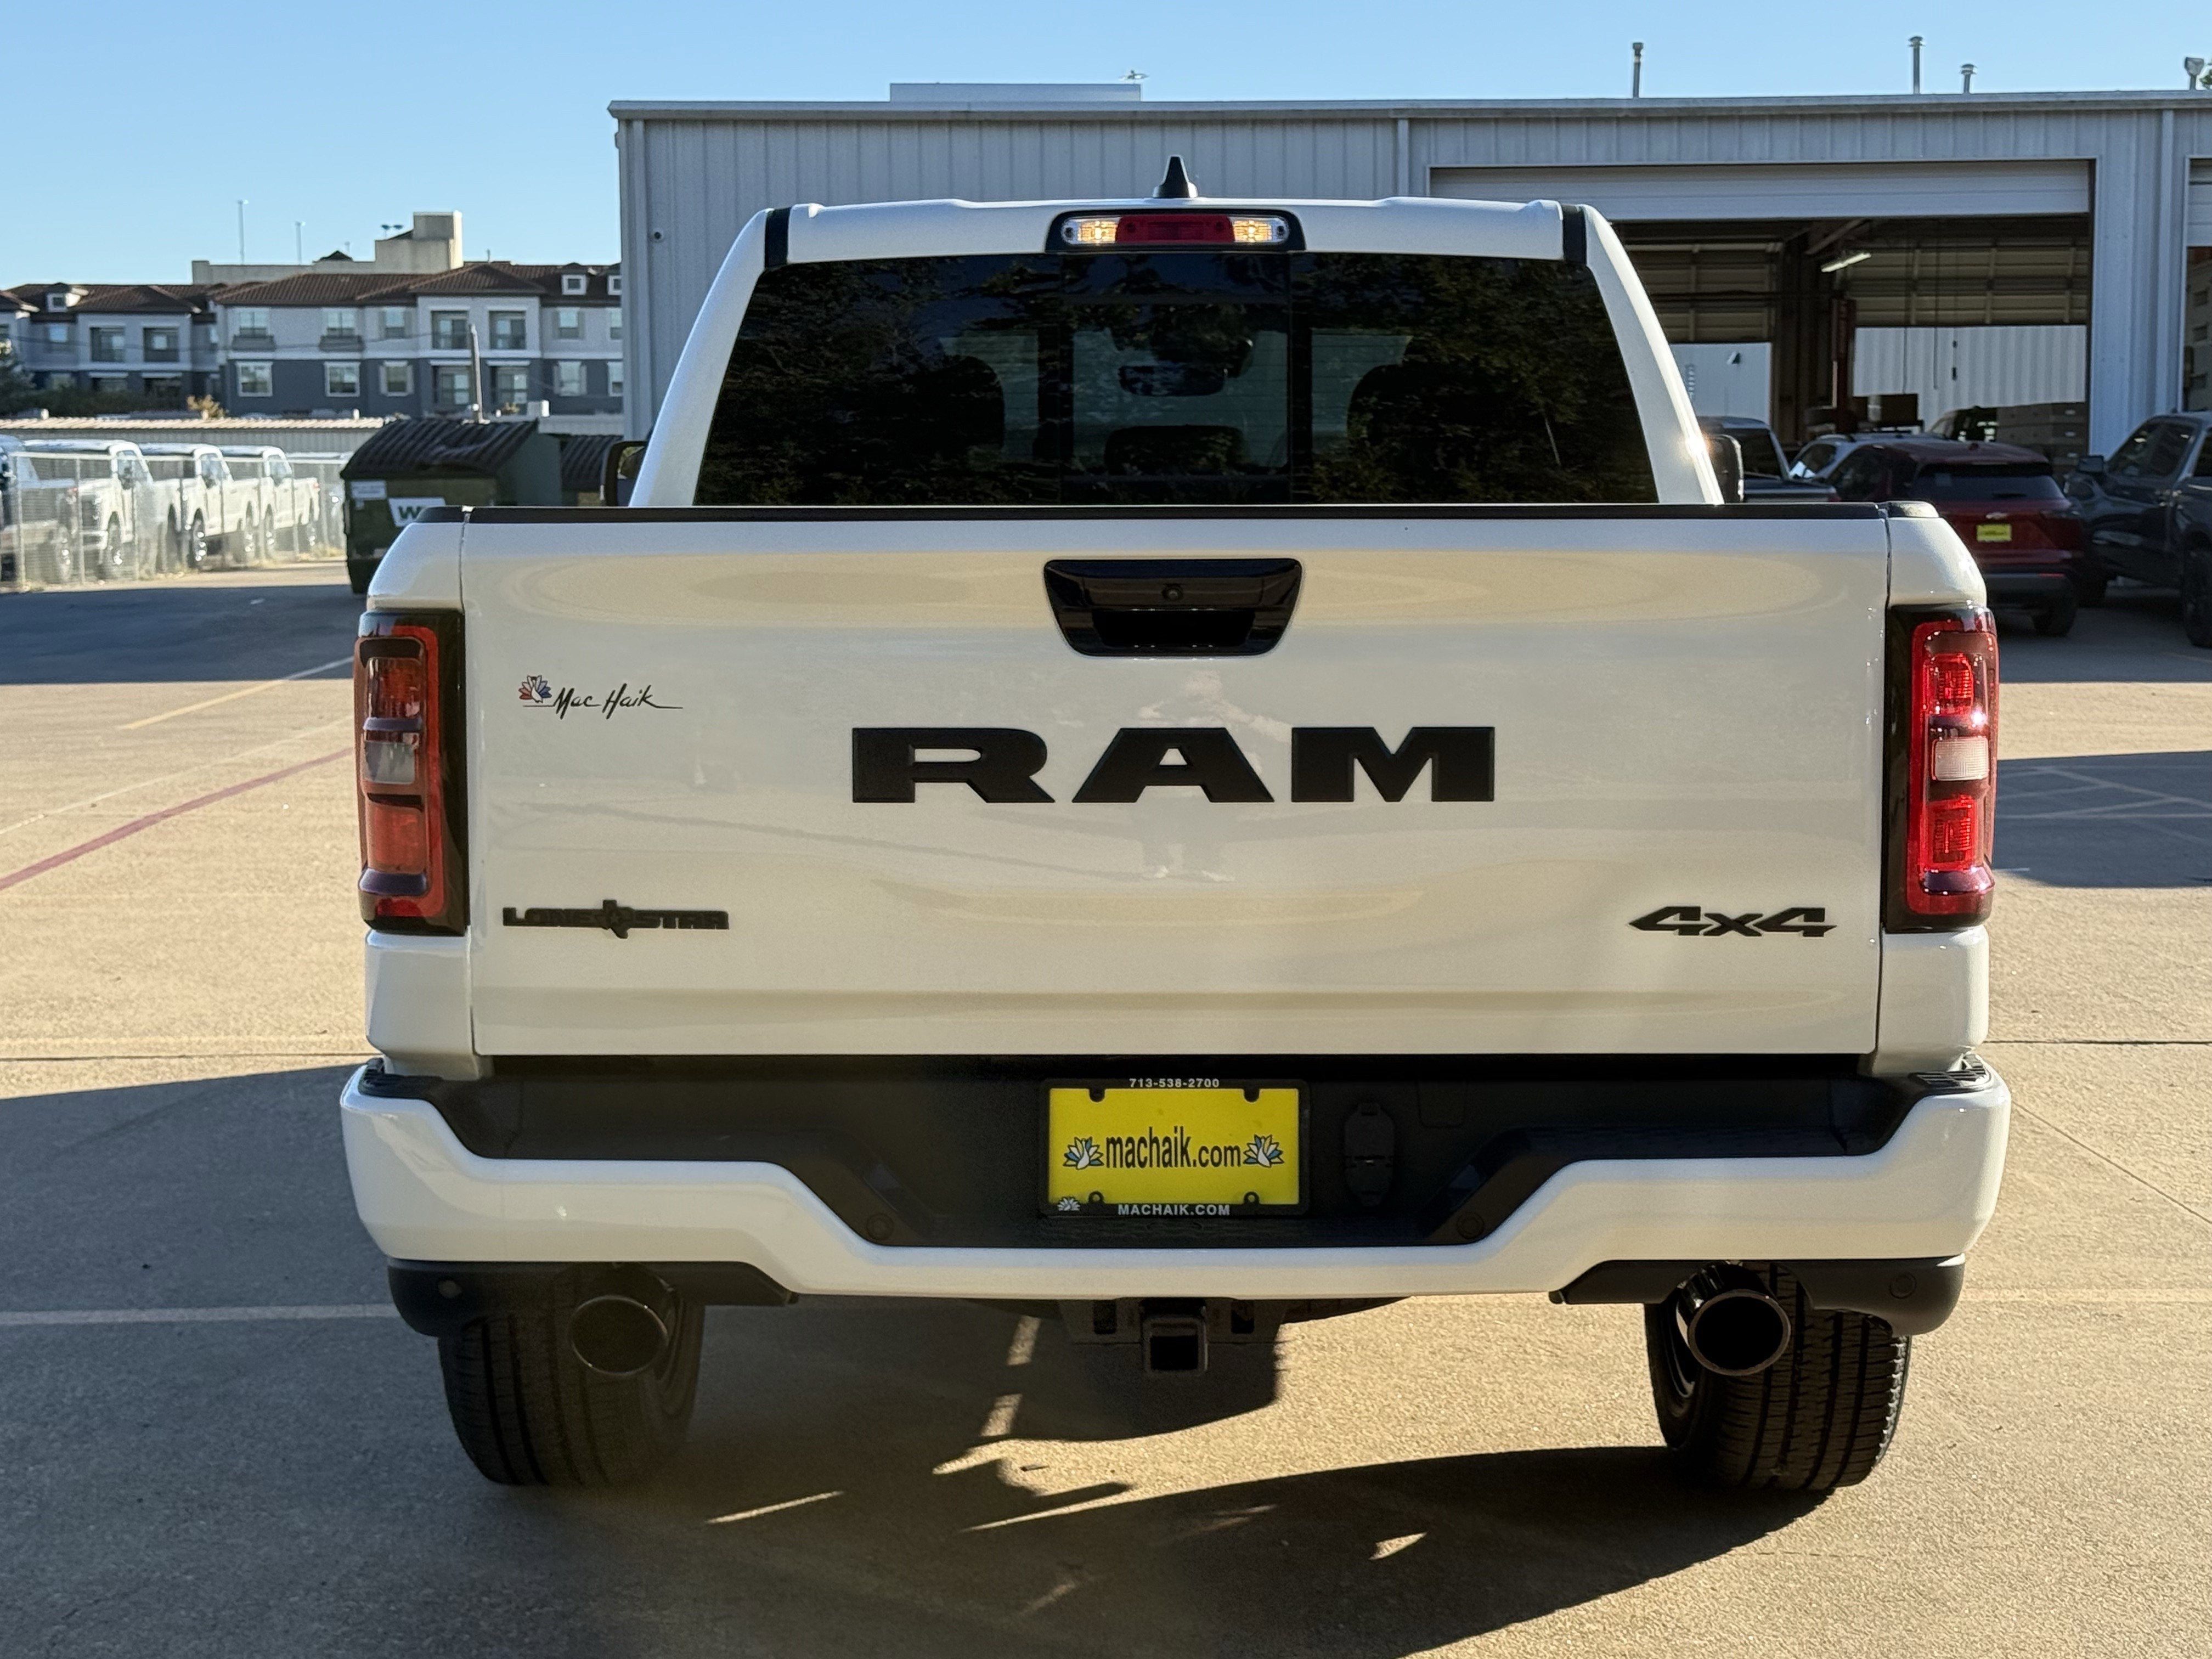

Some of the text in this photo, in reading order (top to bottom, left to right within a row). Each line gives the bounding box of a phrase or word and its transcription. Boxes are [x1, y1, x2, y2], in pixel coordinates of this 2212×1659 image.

[553, 683, 672, 720] Mac Haik
[852, 727, 1496, 803] RAM
[1628, 906, 1838, 937] 4x4
[1128, 1078, 1220, 1088] 713-538-2700
[1105, 1126, 1242, 1169] machaik.com
[1118, 1204, 1231, 1216] MACHAIK.COM
